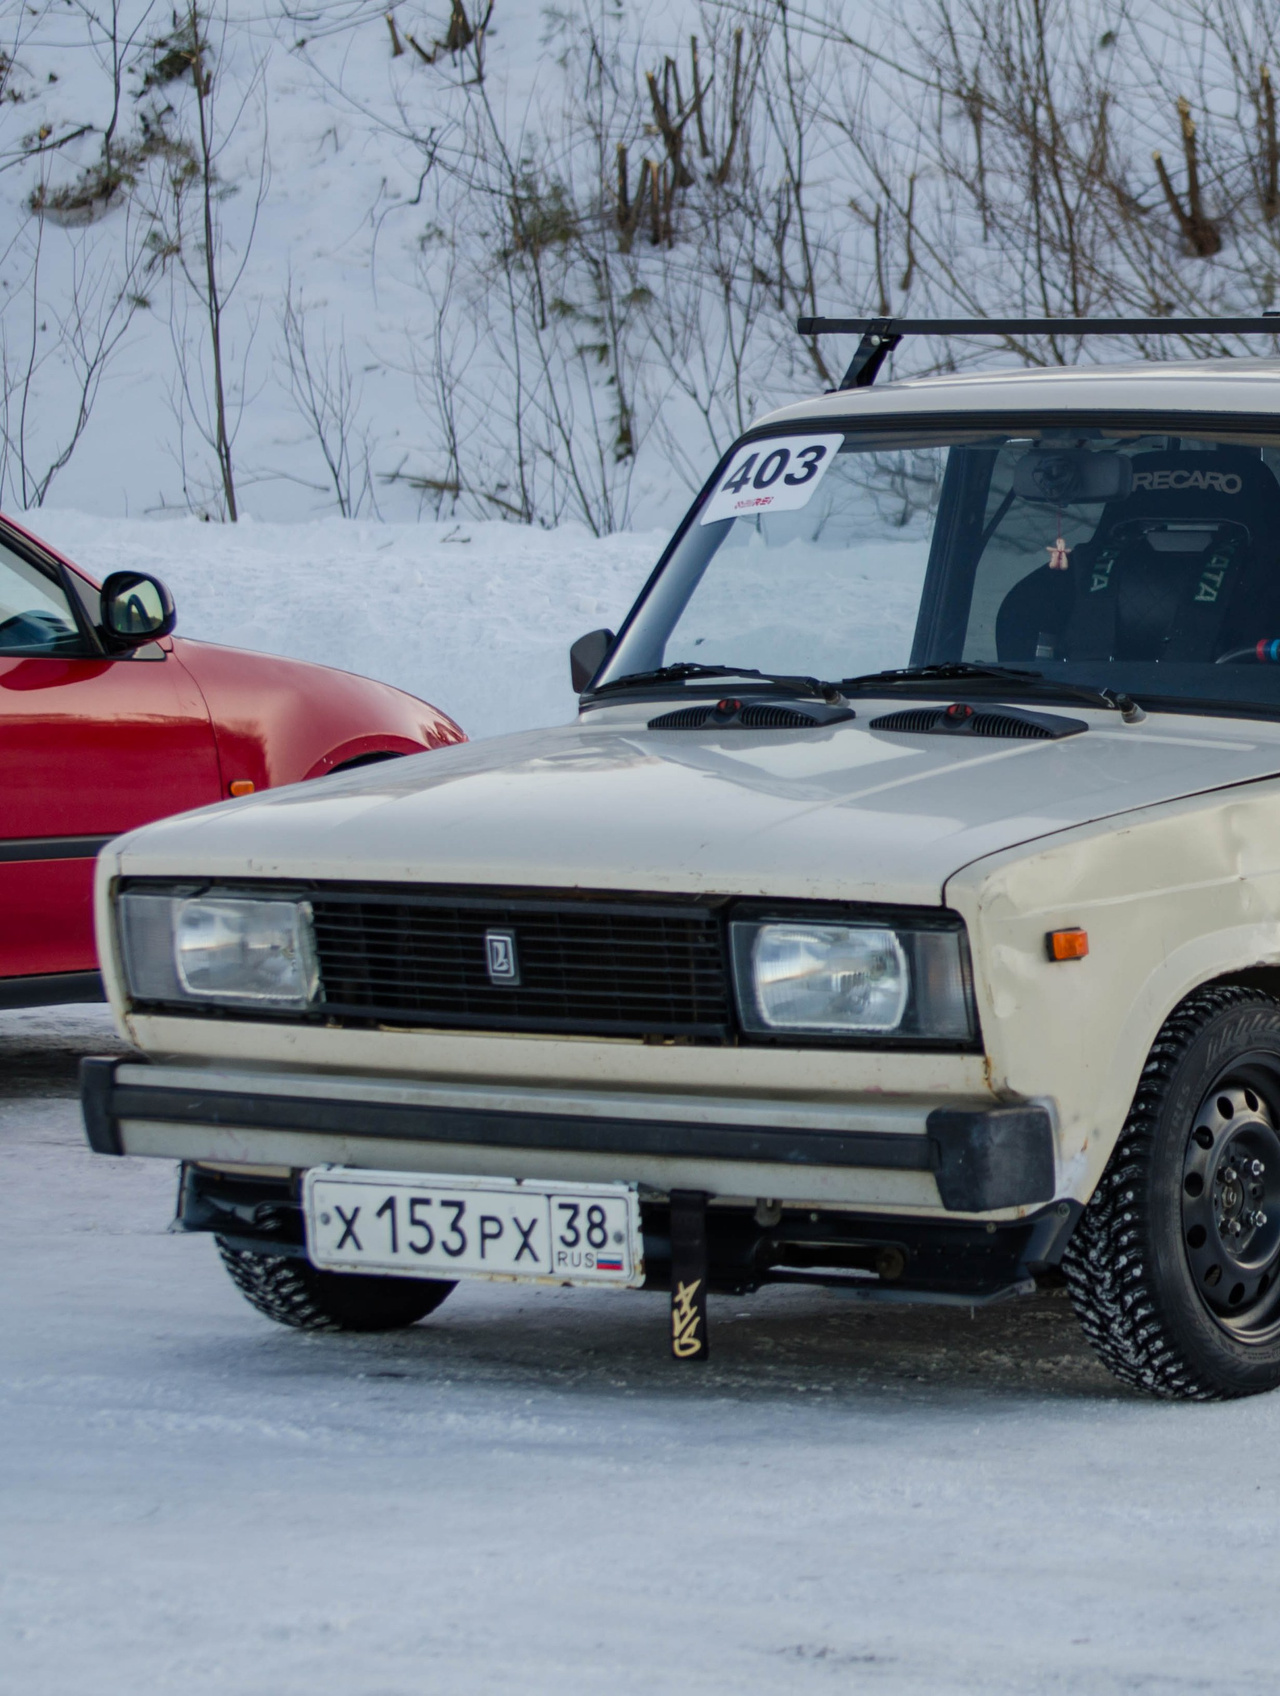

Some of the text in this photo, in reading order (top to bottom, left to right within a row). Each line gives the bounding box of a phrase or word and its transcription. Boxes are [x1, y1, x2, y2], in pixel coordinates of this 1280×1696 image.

[720, 444, 828, 495] 403
[1132, 470, 1243, 494] RECARO
[557, 1202, 609, 1249] 38
[557, 1250, 595, 1268] RUS
